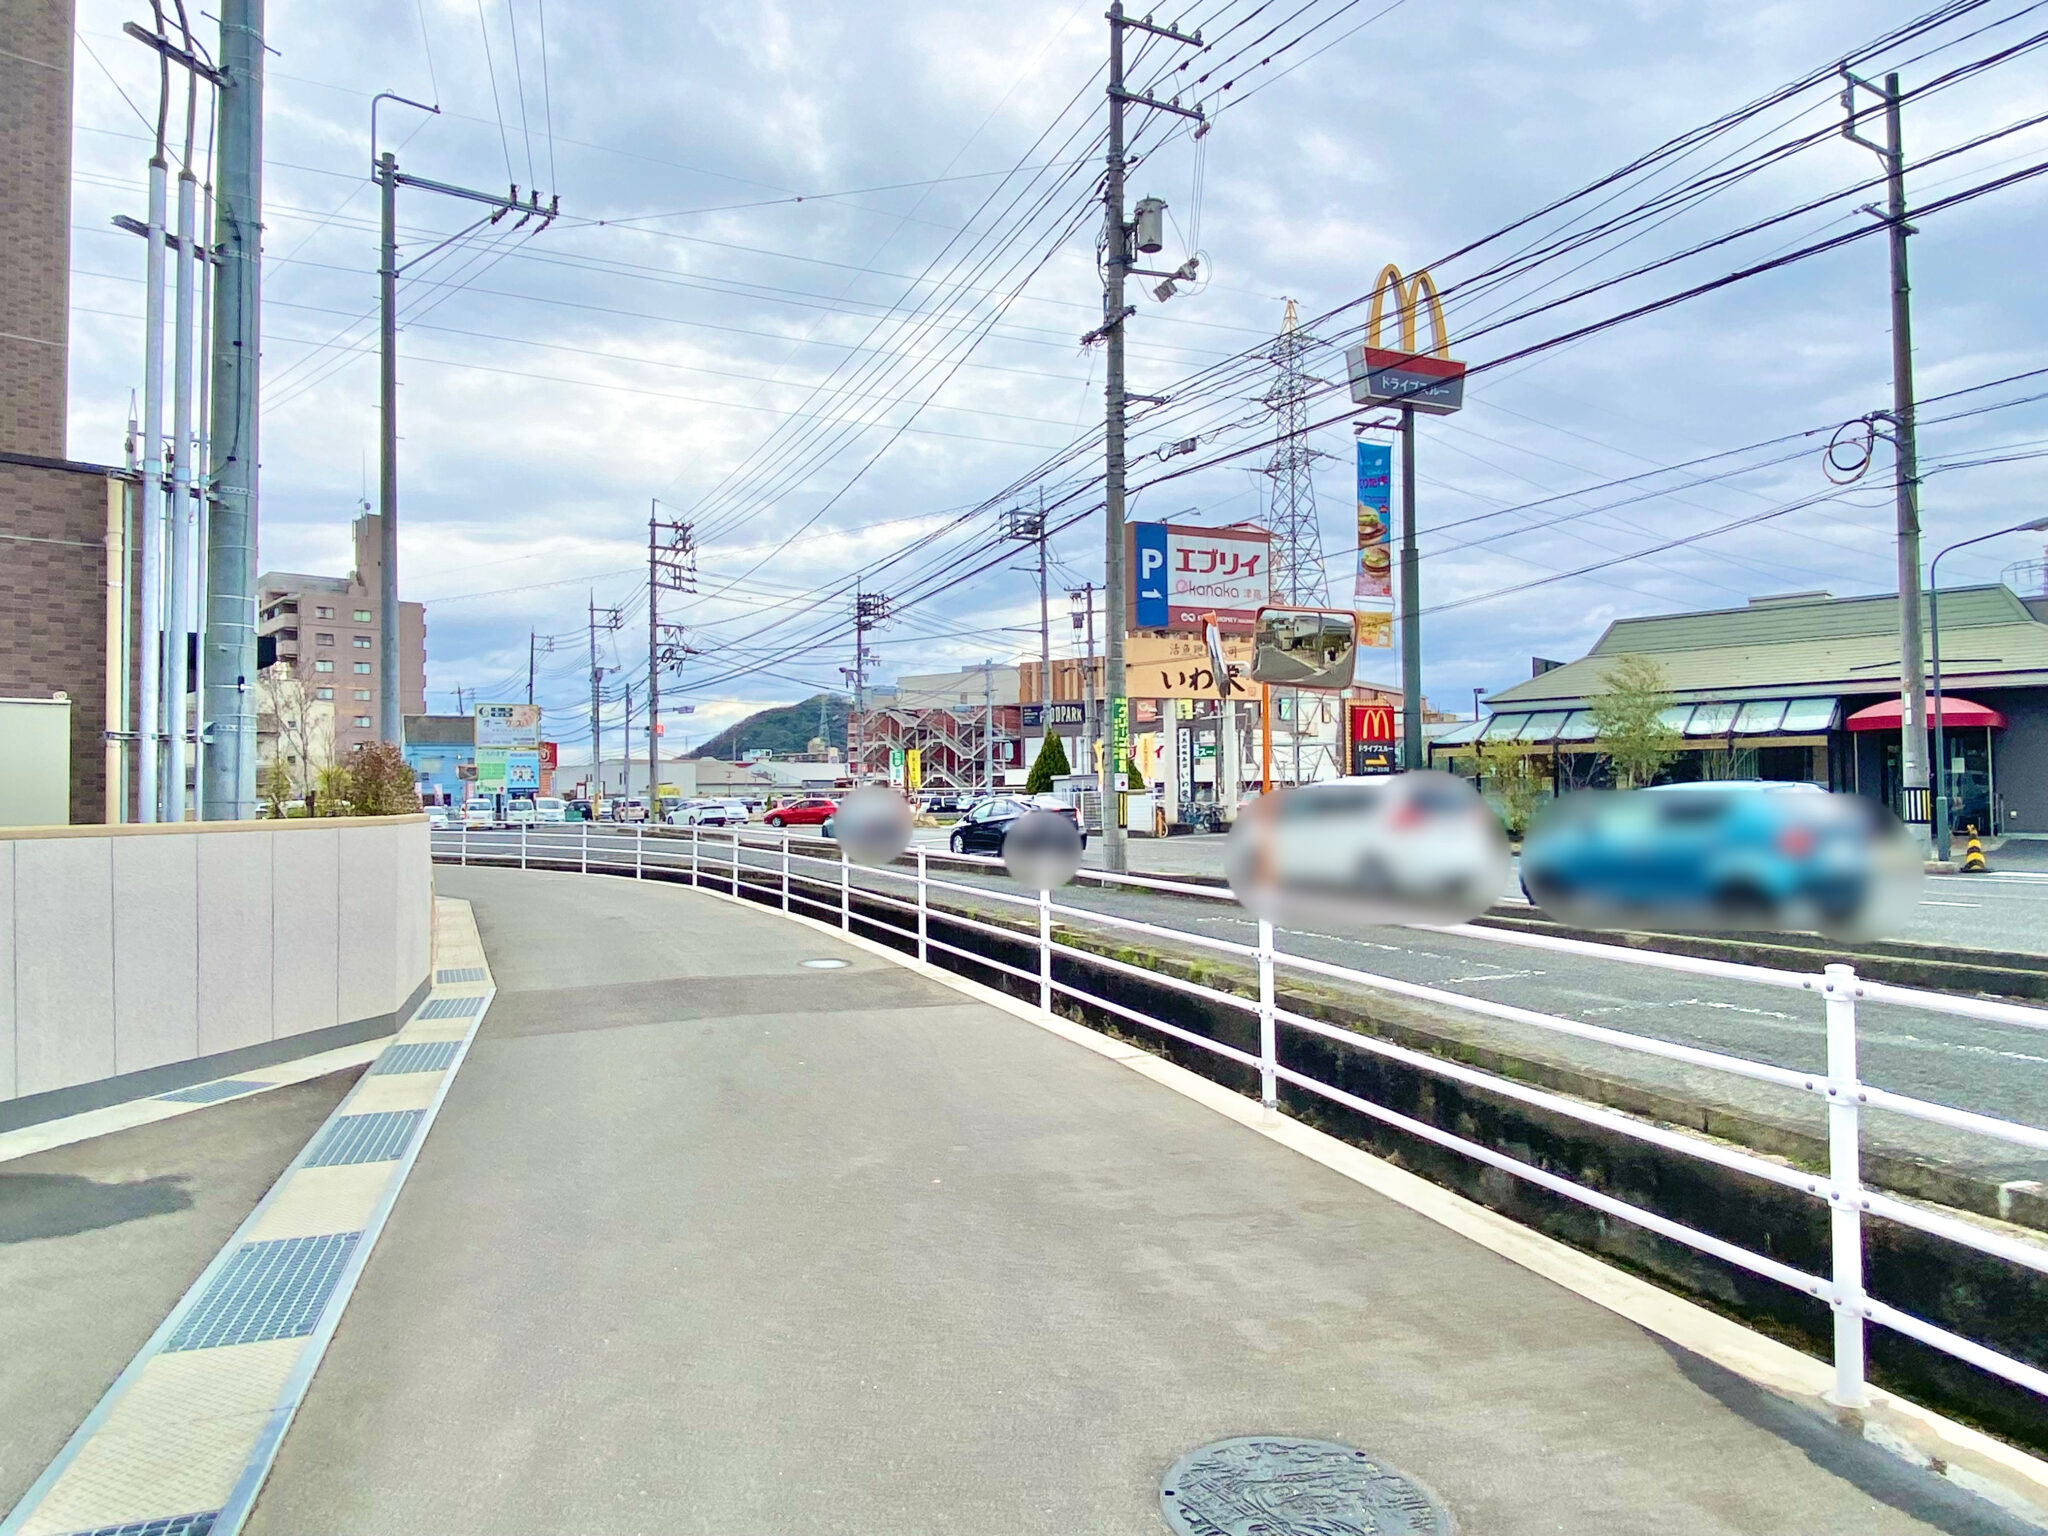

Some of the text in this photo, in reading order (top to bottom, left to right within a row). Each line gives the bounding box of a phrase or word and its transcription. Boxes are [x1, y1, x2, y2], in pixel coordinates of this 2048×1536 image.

[1141, 548, 1163, 580] P
[1175, 548, 1261, 577] エブリイ
[1175, 579, 1239, 599] Okanaka
